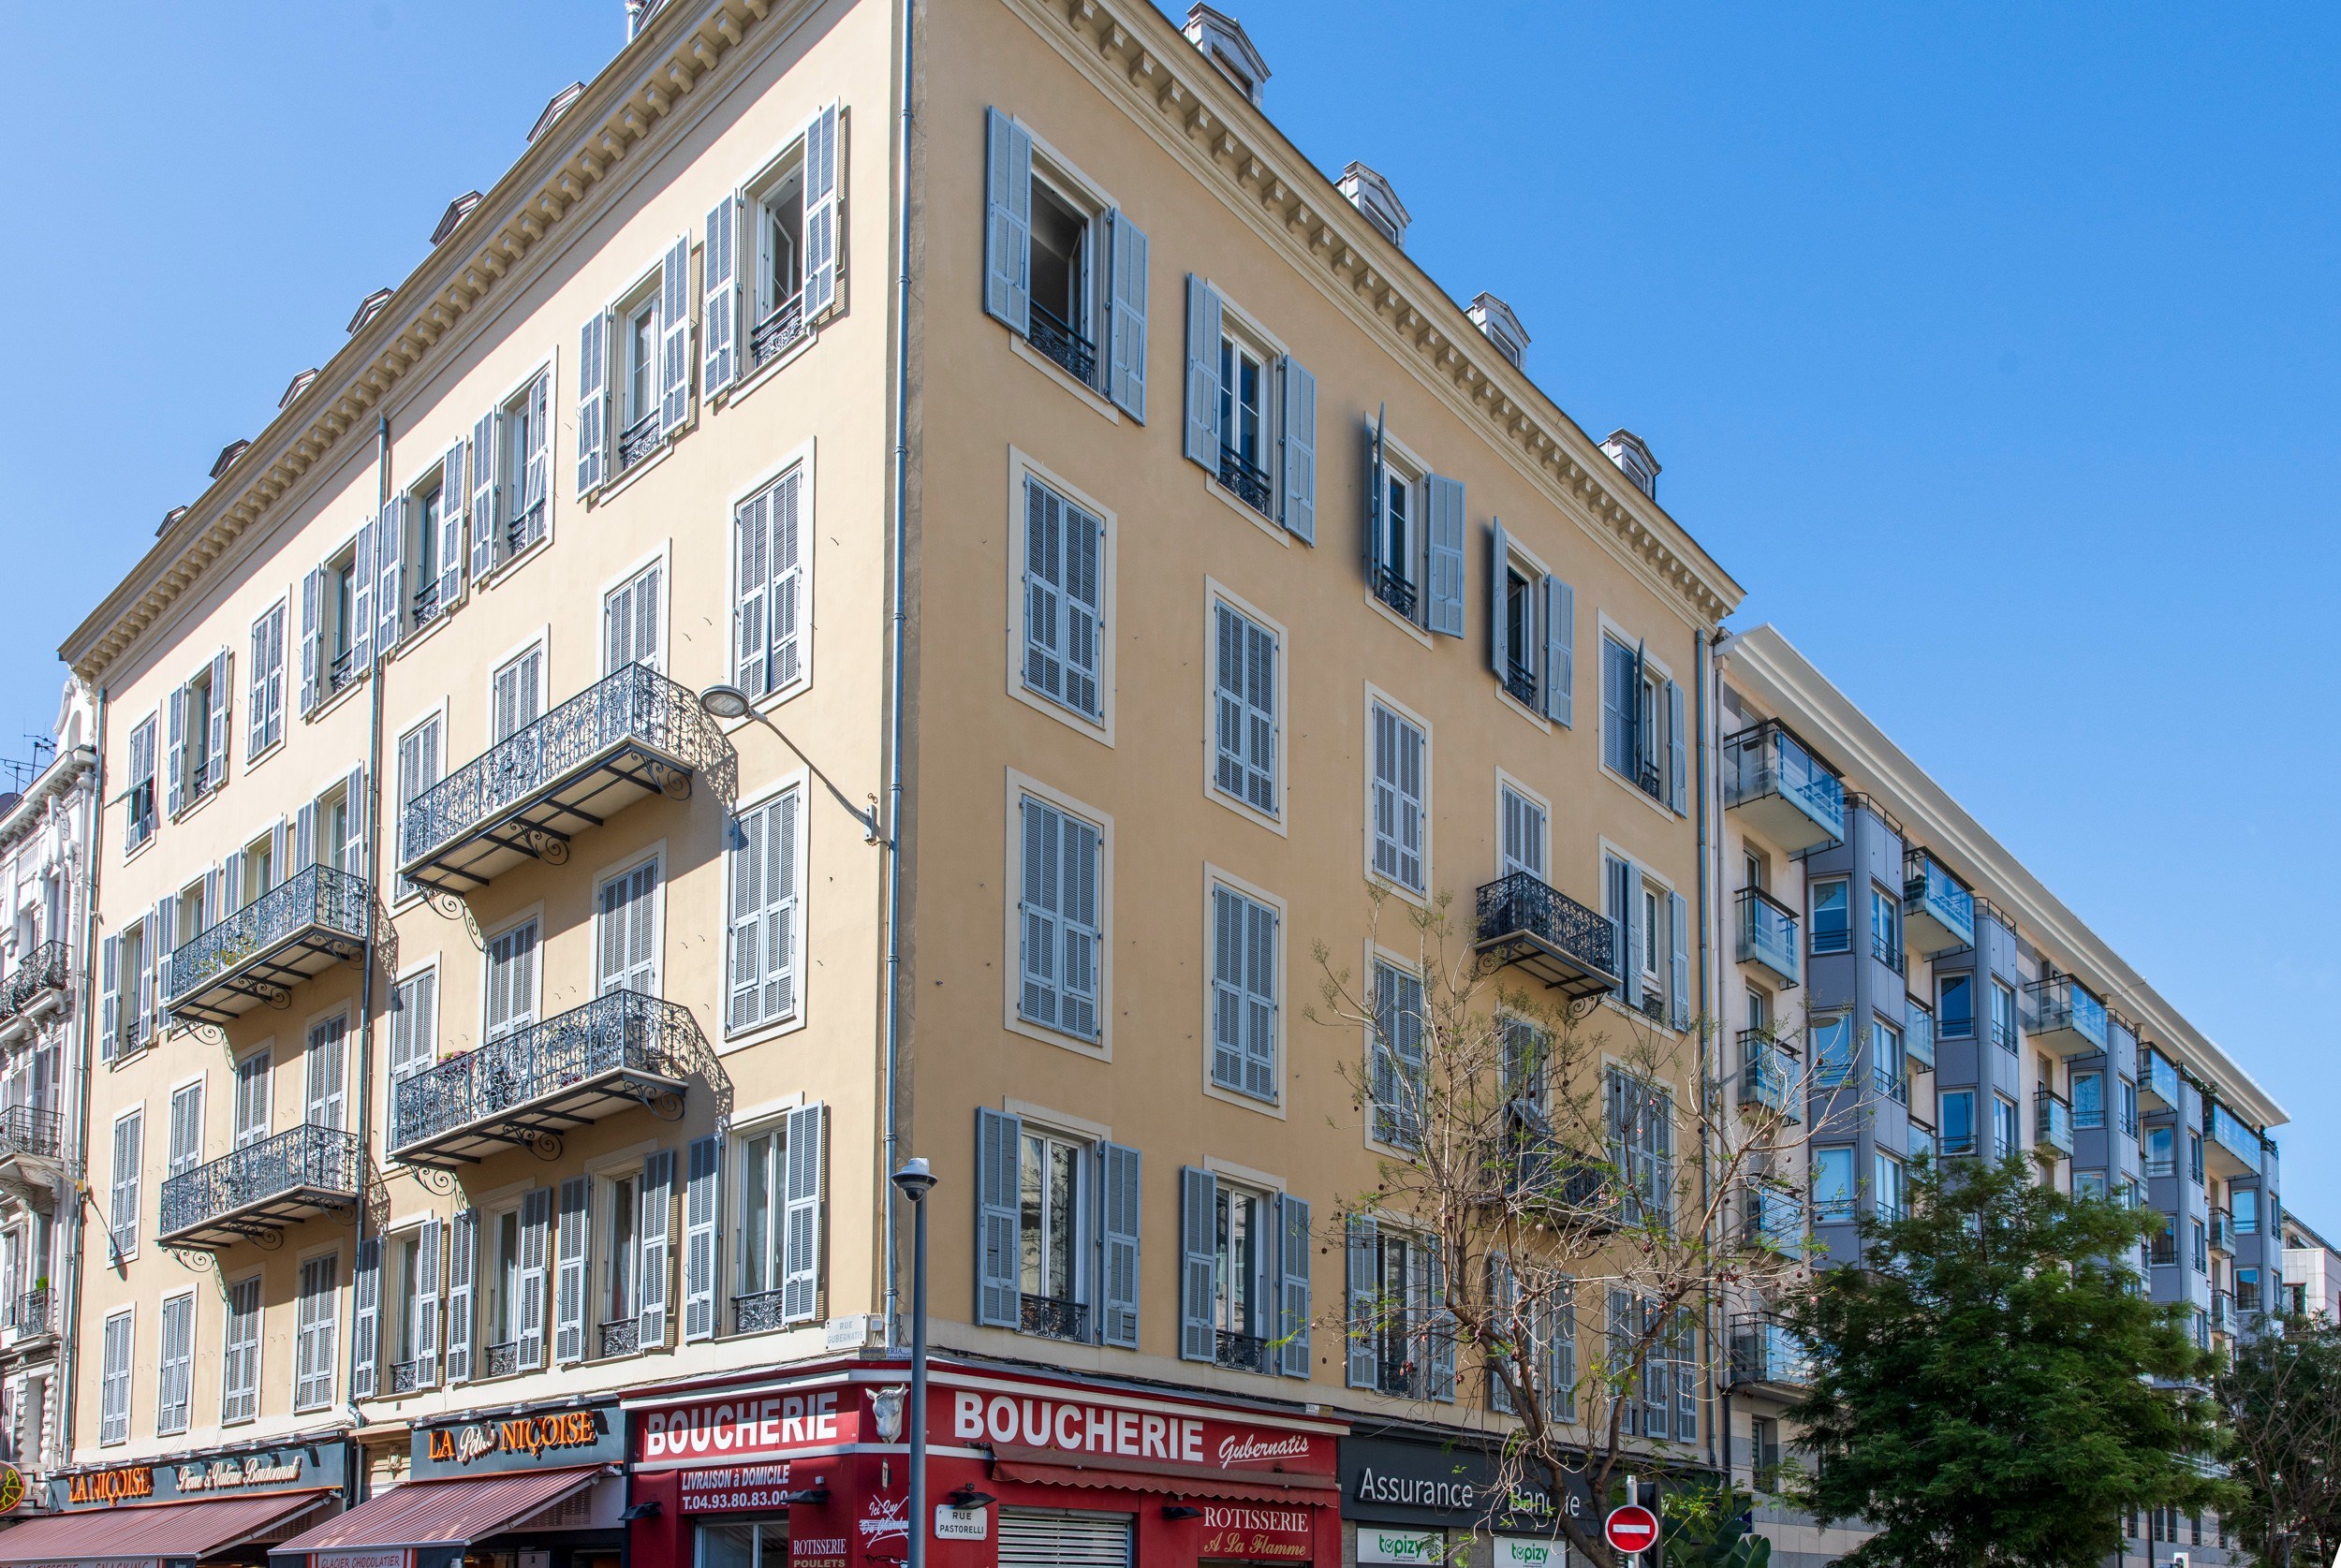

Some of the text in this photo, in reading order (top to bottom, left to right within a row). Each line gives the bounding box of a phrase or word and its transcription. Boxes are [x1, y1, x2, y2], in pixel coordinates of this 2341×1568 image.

[827, 1331, 863, 1344] GUBERNATIS
[839, 1321, 853, 1330] RUE
[428, 1430, 455, 1458] LA
[500, 1412, 595, 1457] NIÇOISE
[647, 1391, 838, 1456] BOUCHERIE
[954, 1391, 1310, 1470] BOUCHERIE Gubernatis
[68, 1476, 89, 1502] LA
[90, 1467, 151, 1505] NIÇOISE
[682, 1464, 790, 1490] LIVRAISON à DOMICILE
[1360, 1467, 1580, 1522] Assurance Bane
[952, 1512, 972, 1520] RUE
[1203, 1506, 1308, 1532] ROTISSERIE
[939, 1525, 984, 1534] PASTORELLI
[793, 1538, 847, 1555] ROTISSERIE
[1203, 1531, 1306, 1556] A La Flamme
[1378, 1534, 1423, 1559] topizy
[1511, 1542, 1549, 1564] topizy
[321, 1555, 400, 1568] GLACIER CHOCOLATIER
[793, 1559, 846, 1568] POULETS
